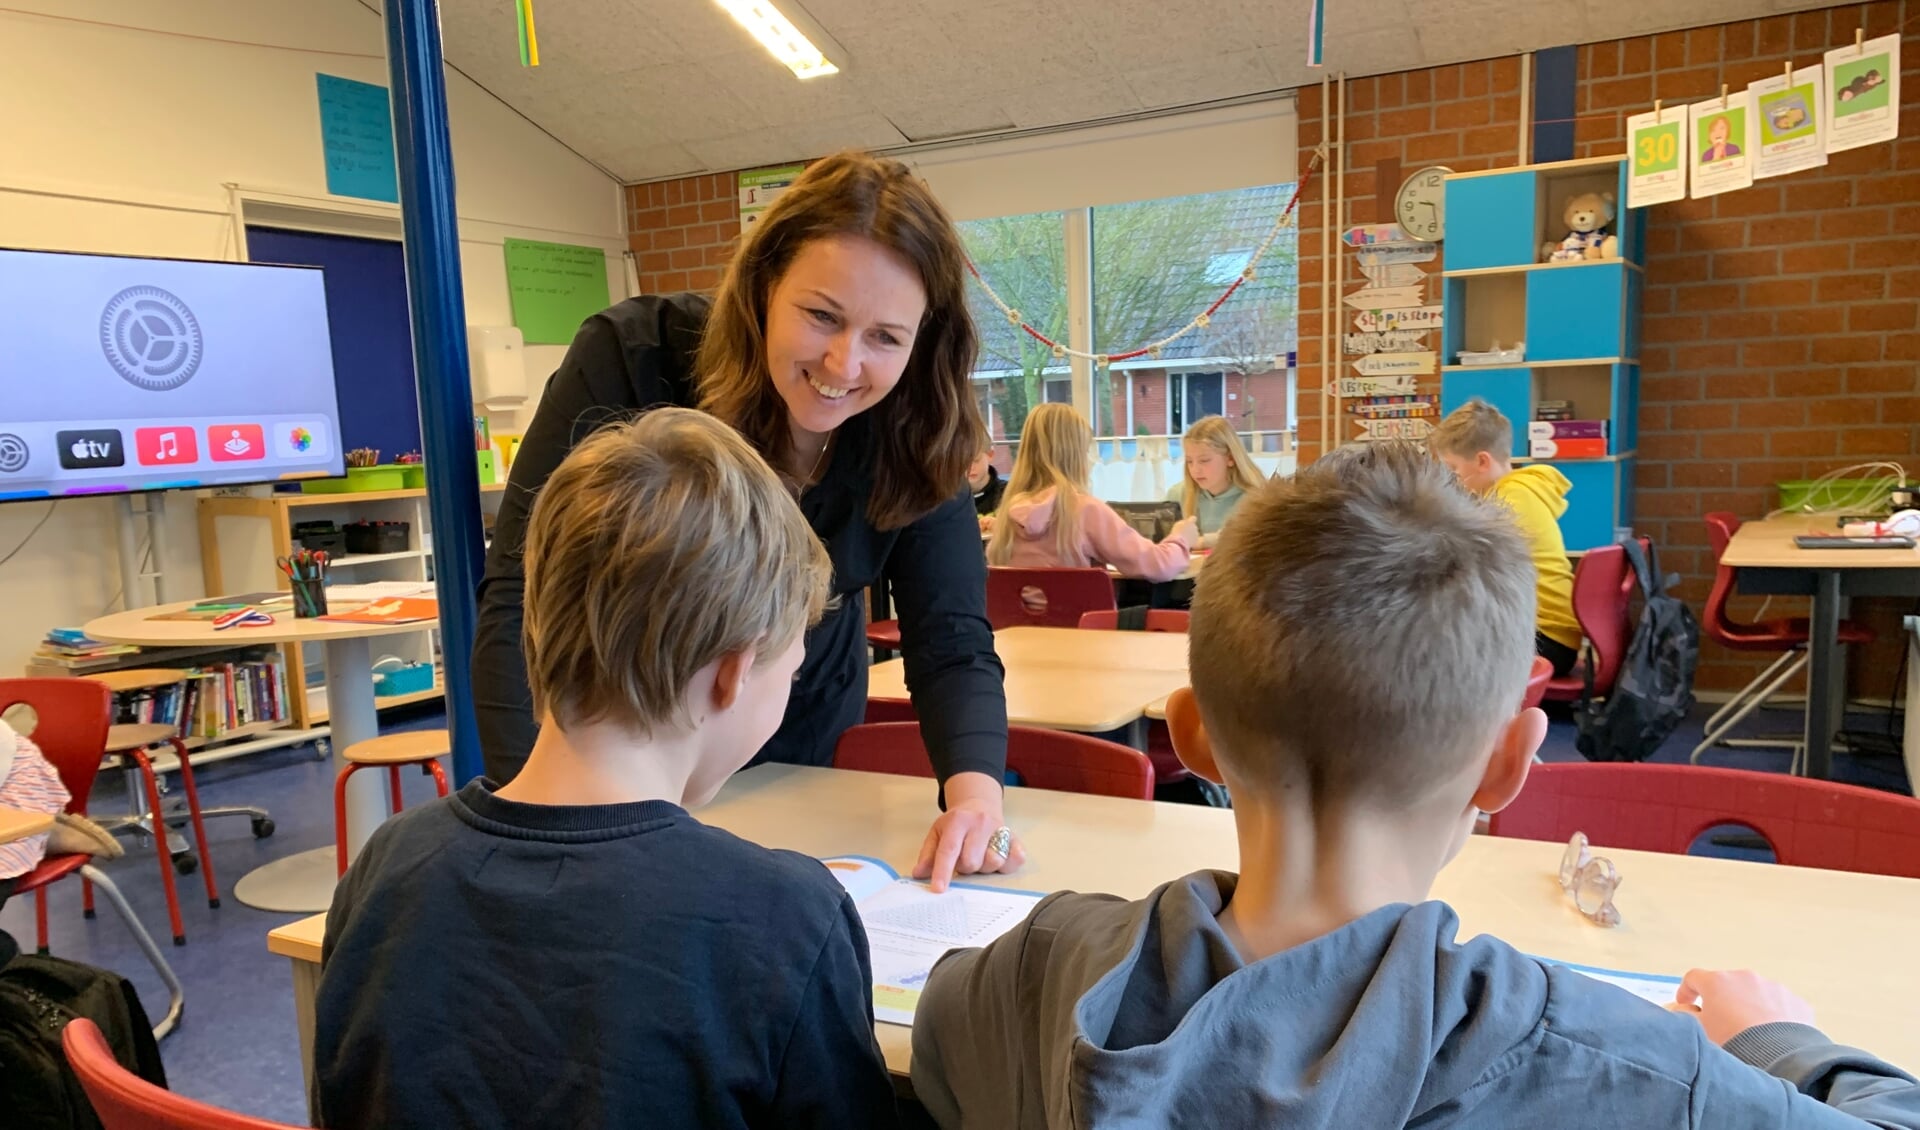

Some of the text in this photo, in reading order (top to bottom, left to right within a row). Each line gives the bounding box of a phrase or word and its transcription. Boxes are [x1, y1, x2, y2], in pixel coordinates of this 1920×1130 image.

[1638, 133, 1676, 168] 30
[1427, 176, 1440, 187] 12
[1405, 201, 1414, 212] 9
[1428, 222, 1438, 233] 6
[88, 440, 110, 458] tv
